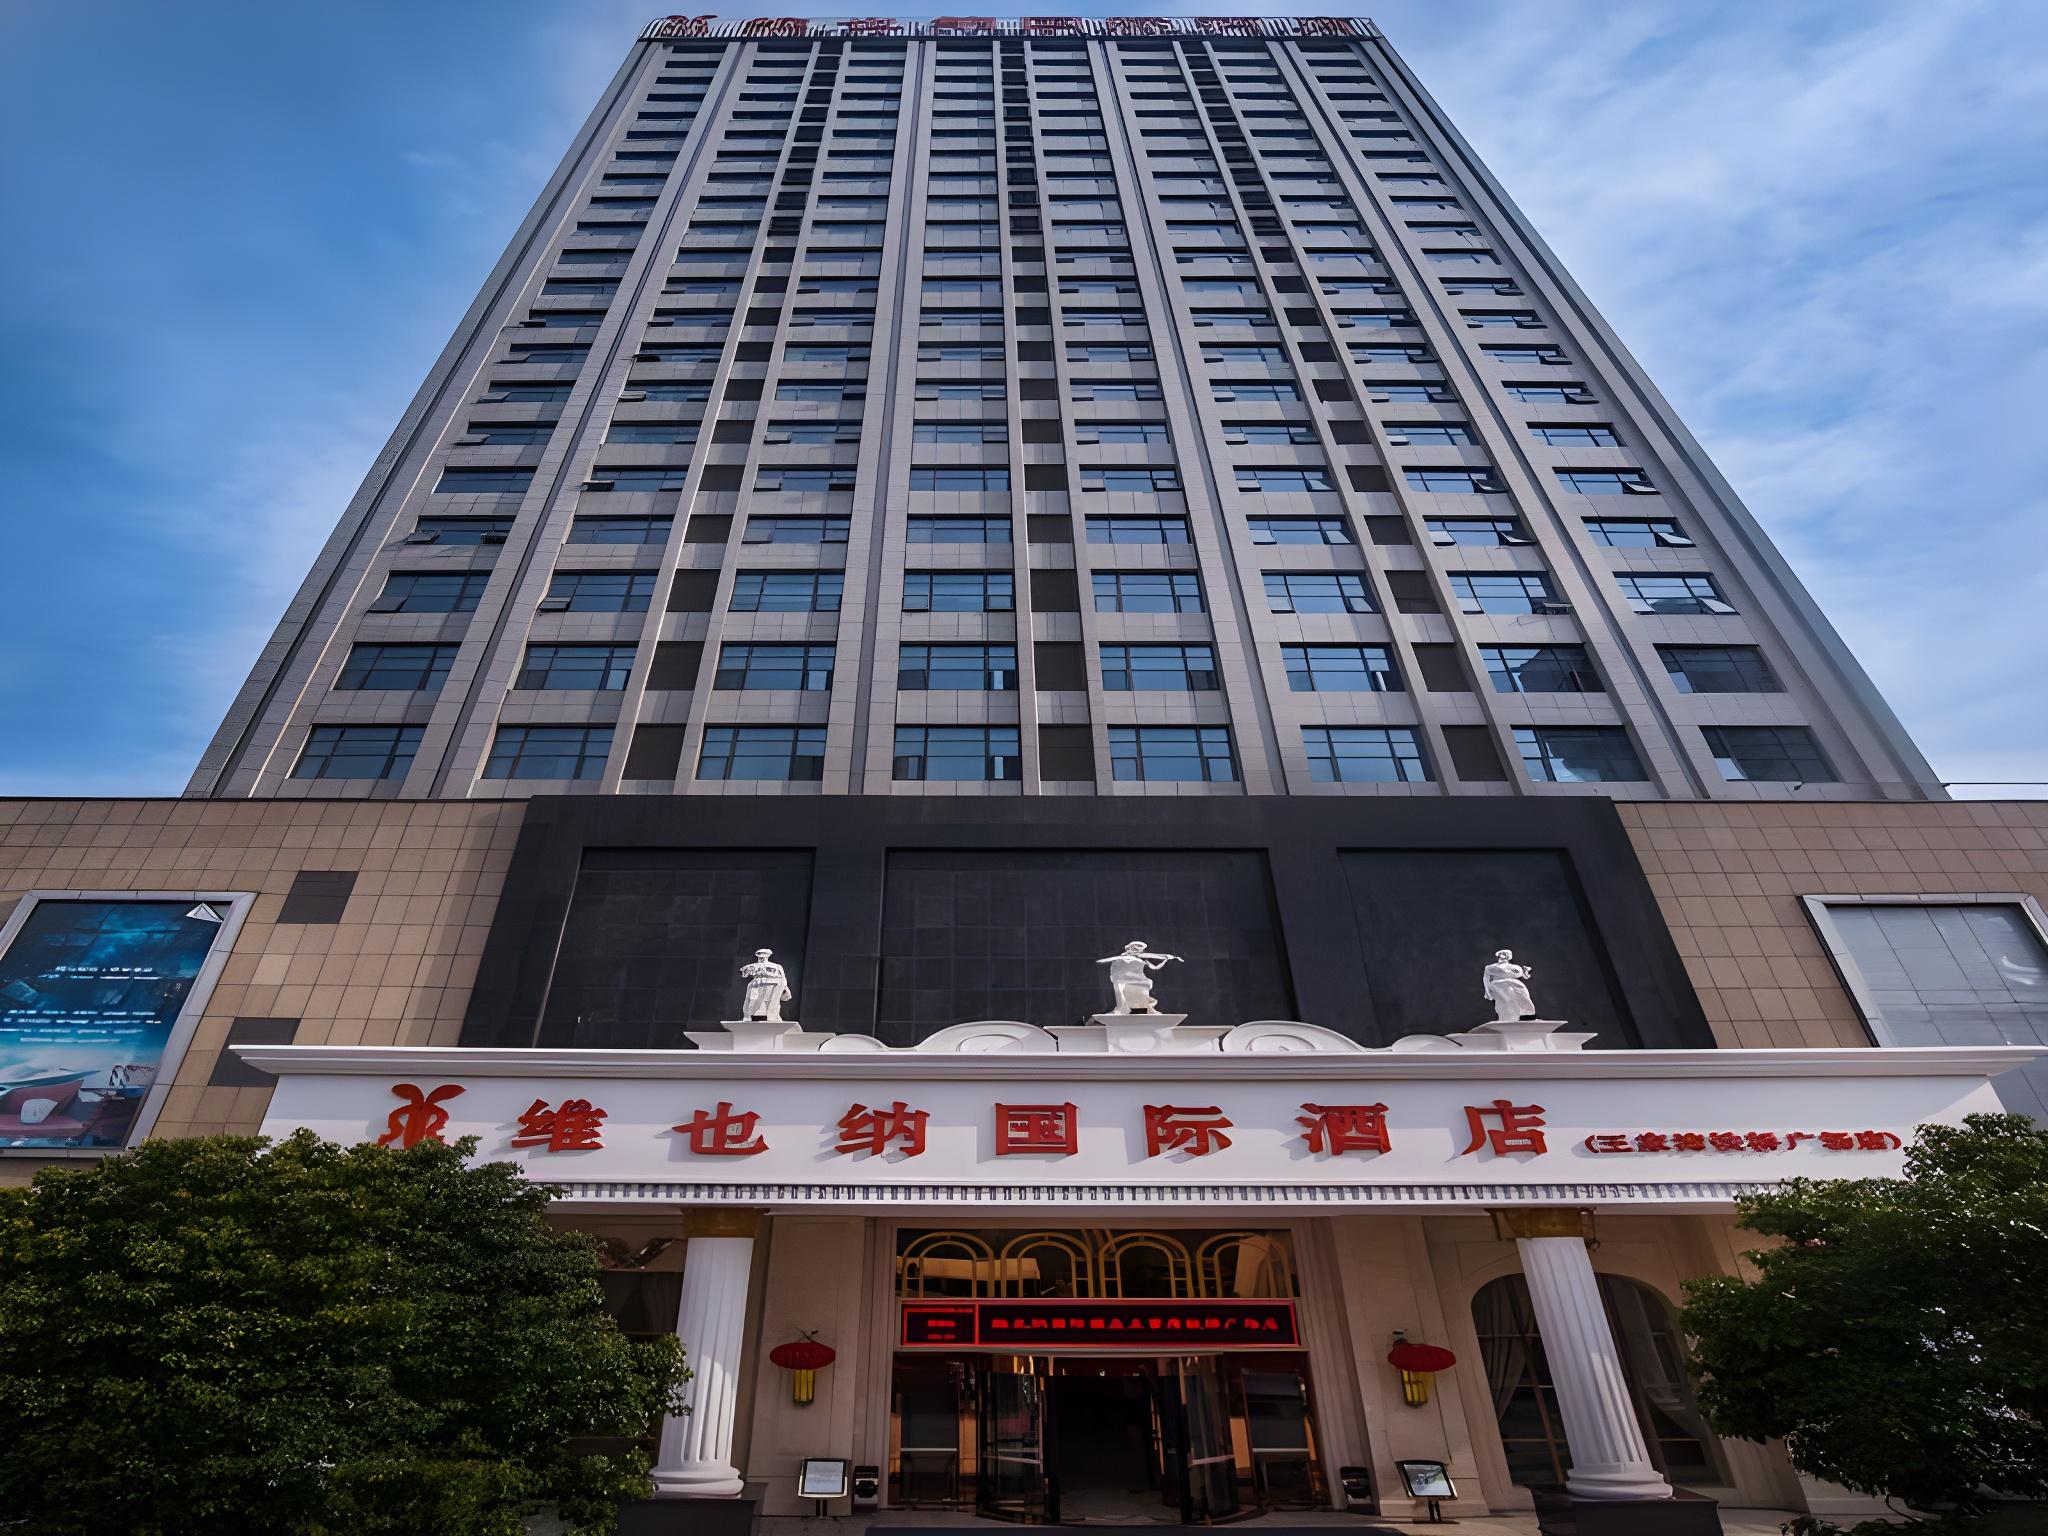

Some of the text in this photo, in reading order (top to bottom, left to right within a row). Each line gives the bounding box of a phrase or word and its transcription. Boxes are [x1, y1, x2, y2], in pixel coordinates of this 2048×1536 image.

[511, 1099, 1547, 1156] 维也纳国际酒店
